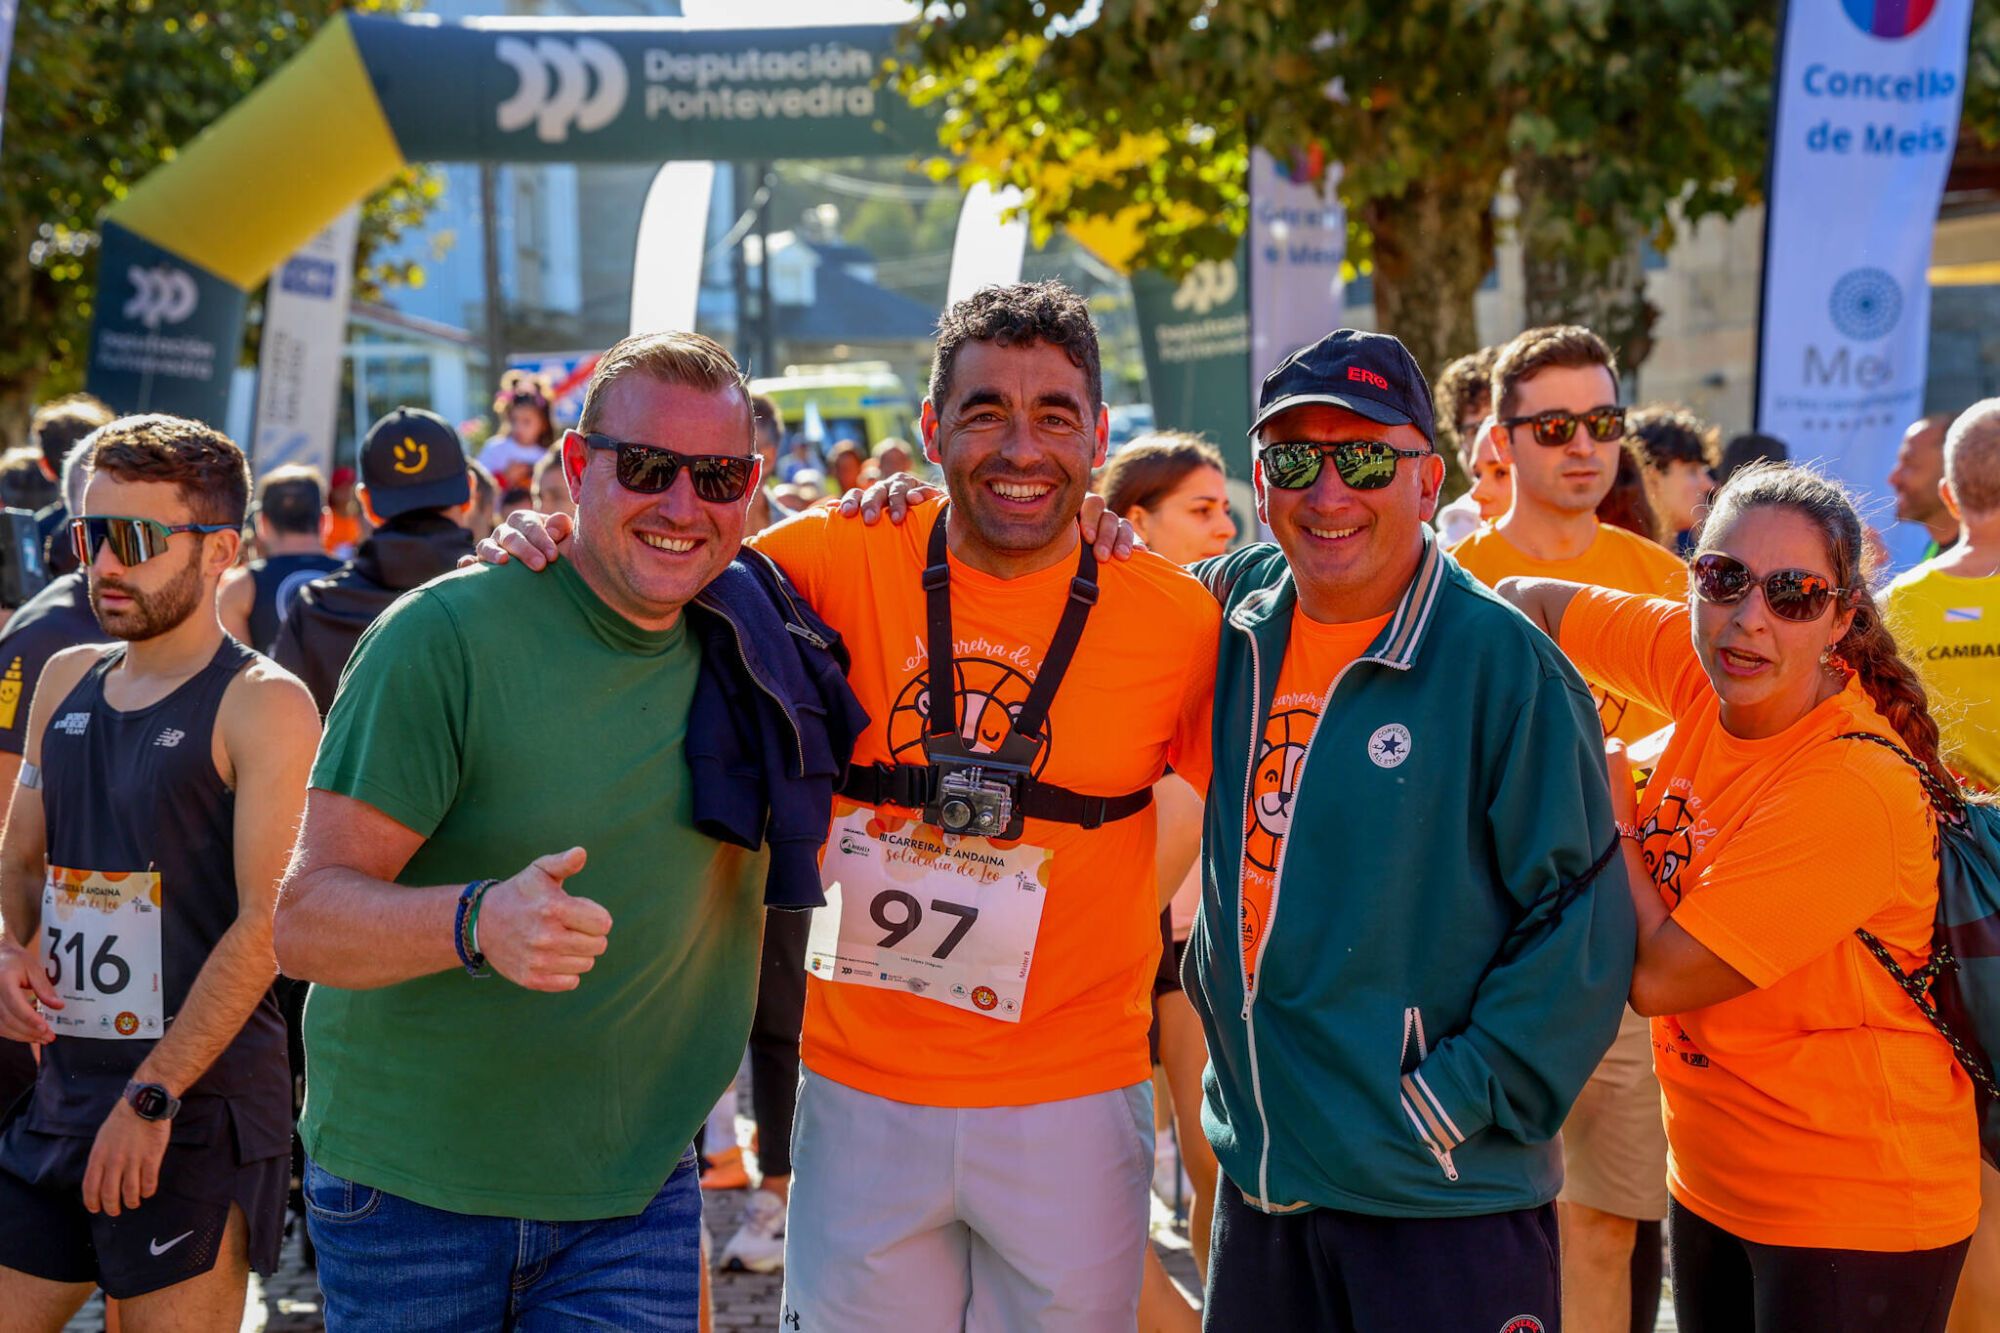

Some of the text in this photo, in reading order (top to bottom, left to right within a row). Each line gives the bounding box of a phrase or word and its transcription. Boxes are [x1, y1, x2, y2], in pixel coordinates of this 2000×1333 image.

[643, 42, 874, 87] Deputación
[1803, 64, 1956, 101] Concello
[644, 81, 876, 120] Pontevedra
[1807, 119, 1946, 157] de Meis
[1009, 645, 1030, 667] de
[1378, 727, 1408, 741] CONVERSE
[879, 832, 1006, 867] III CARREIRA E ANDAINA
[885, 847, 953, 872] solidaria
[956, 862, 976, 877] de
[977, 865, 1001, 885] Leo
[86, 886, 121, 897] ANDAINA
[869, 889, 979, 960] 97
[45, 926, 131, 995] 316
